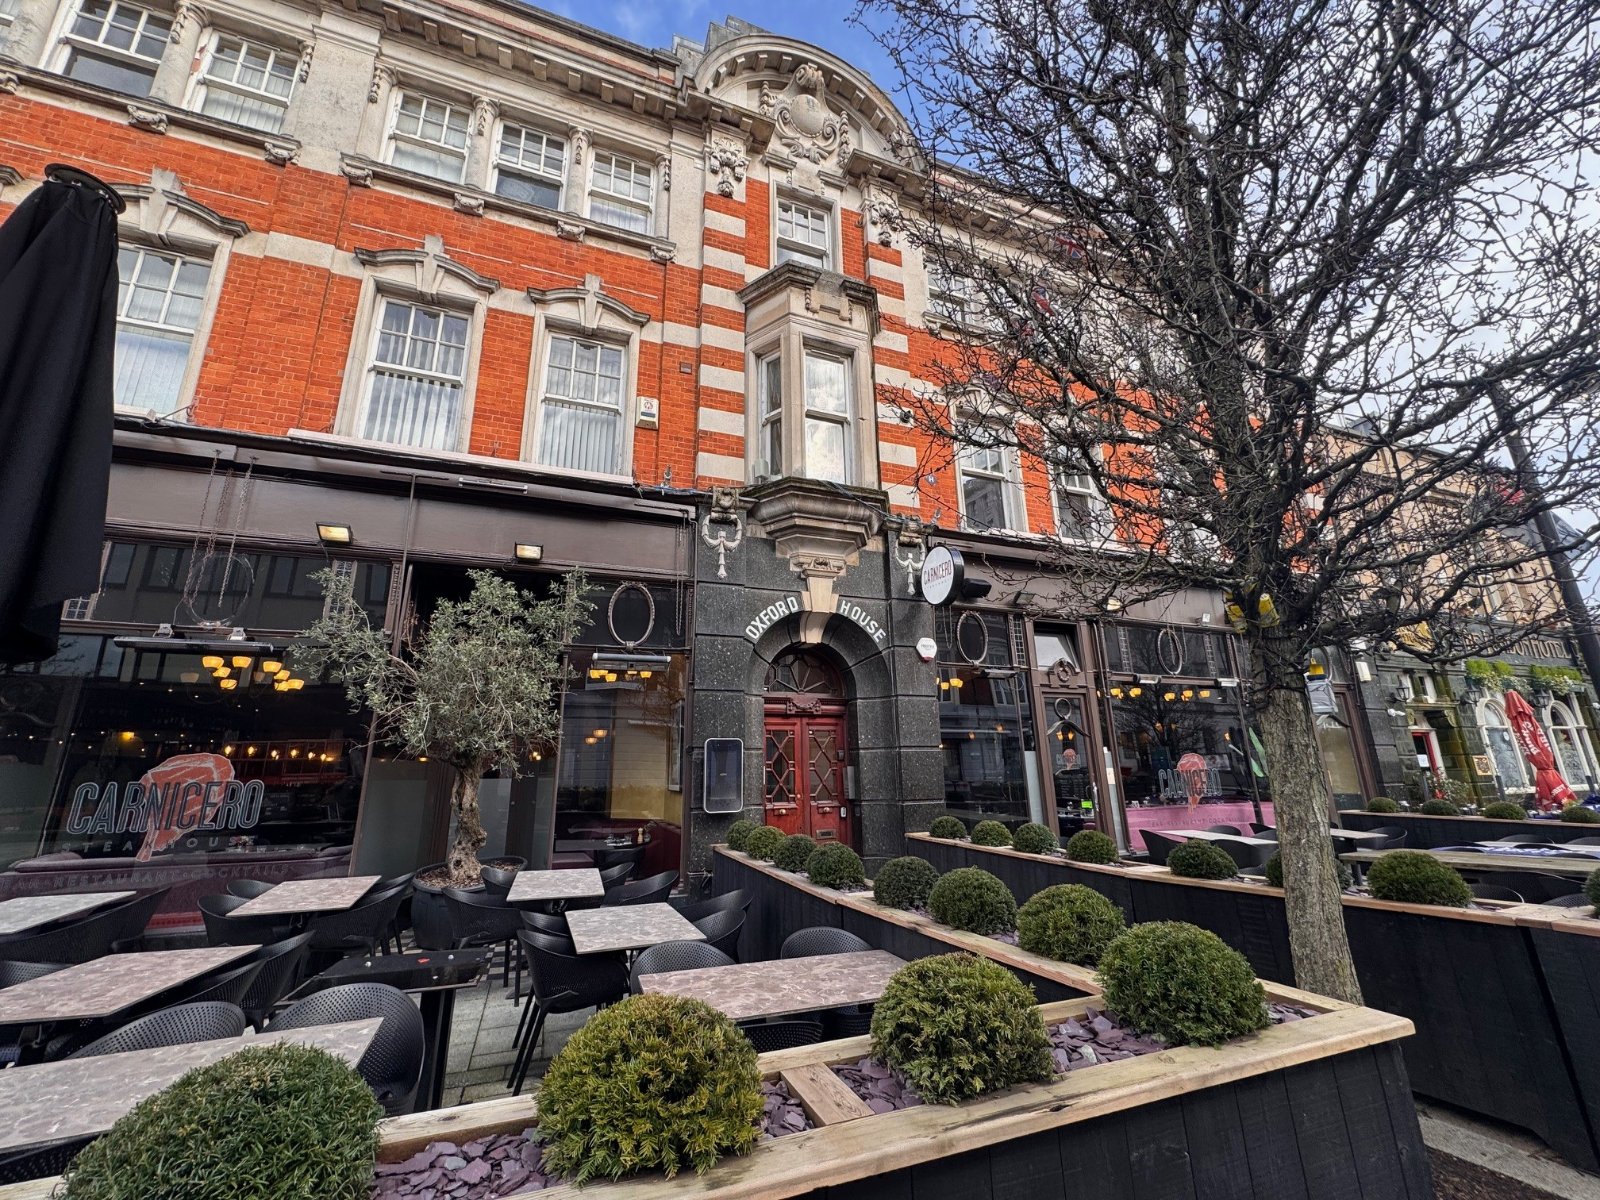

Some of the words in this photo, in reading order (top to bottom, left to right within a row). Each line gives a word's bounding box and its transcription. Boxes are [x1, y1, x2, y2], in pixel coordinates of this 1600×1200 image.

[923, 560, 952, 585] CARNICERO
[745, 596, 799, 639] OXFORD
[840, 600, 886, 642] HOUSE
[1158, 767, 1222, 798] CARNICERO
[66, 779, 265, 834] CARNICERO
